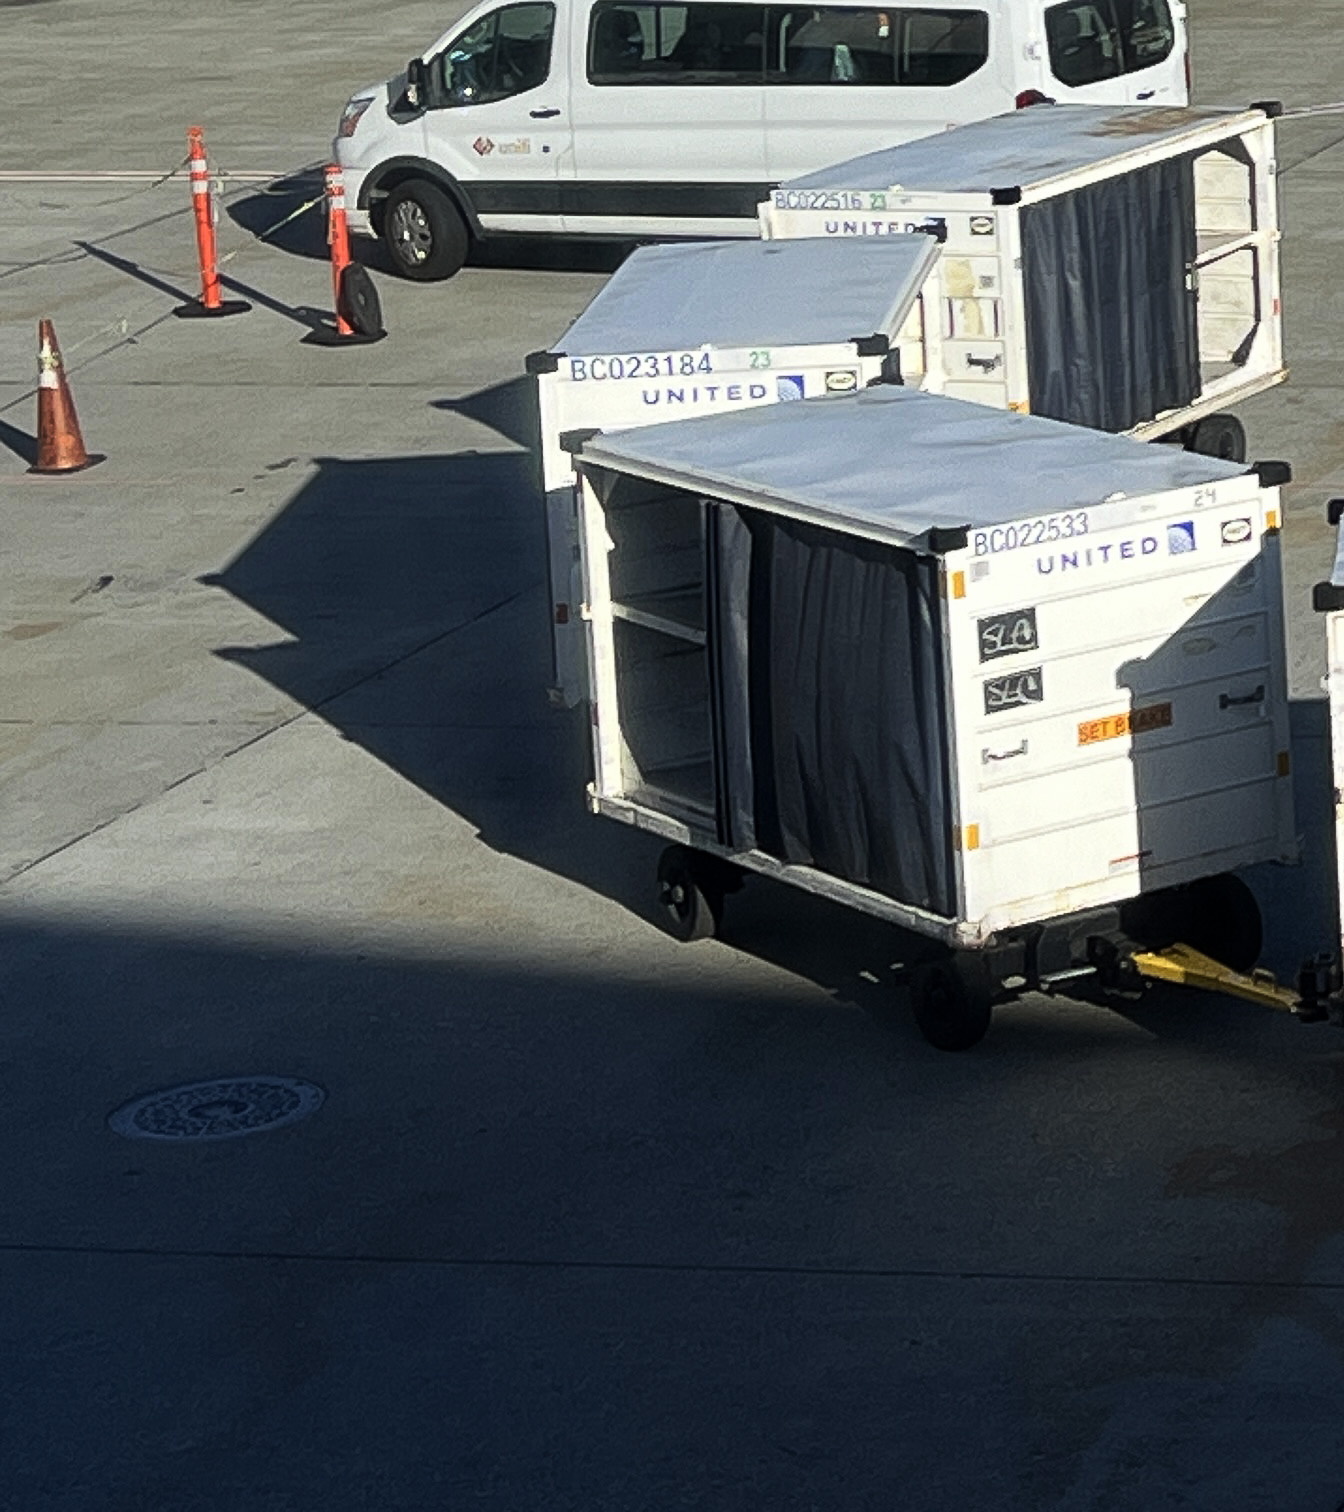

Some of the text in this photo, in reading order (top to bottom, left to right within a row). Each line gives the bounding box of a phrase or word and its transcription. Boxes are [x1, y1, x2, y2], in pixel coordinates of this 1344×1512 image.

[571, 351, 772, 382] BC023184 23
[643, 383, 768, 405] UNITED
[974, 512, 1089, 556] BC022533
[1037, 536, 1158, 575] UNITED
[1079, 719, 1110, 743] SET
